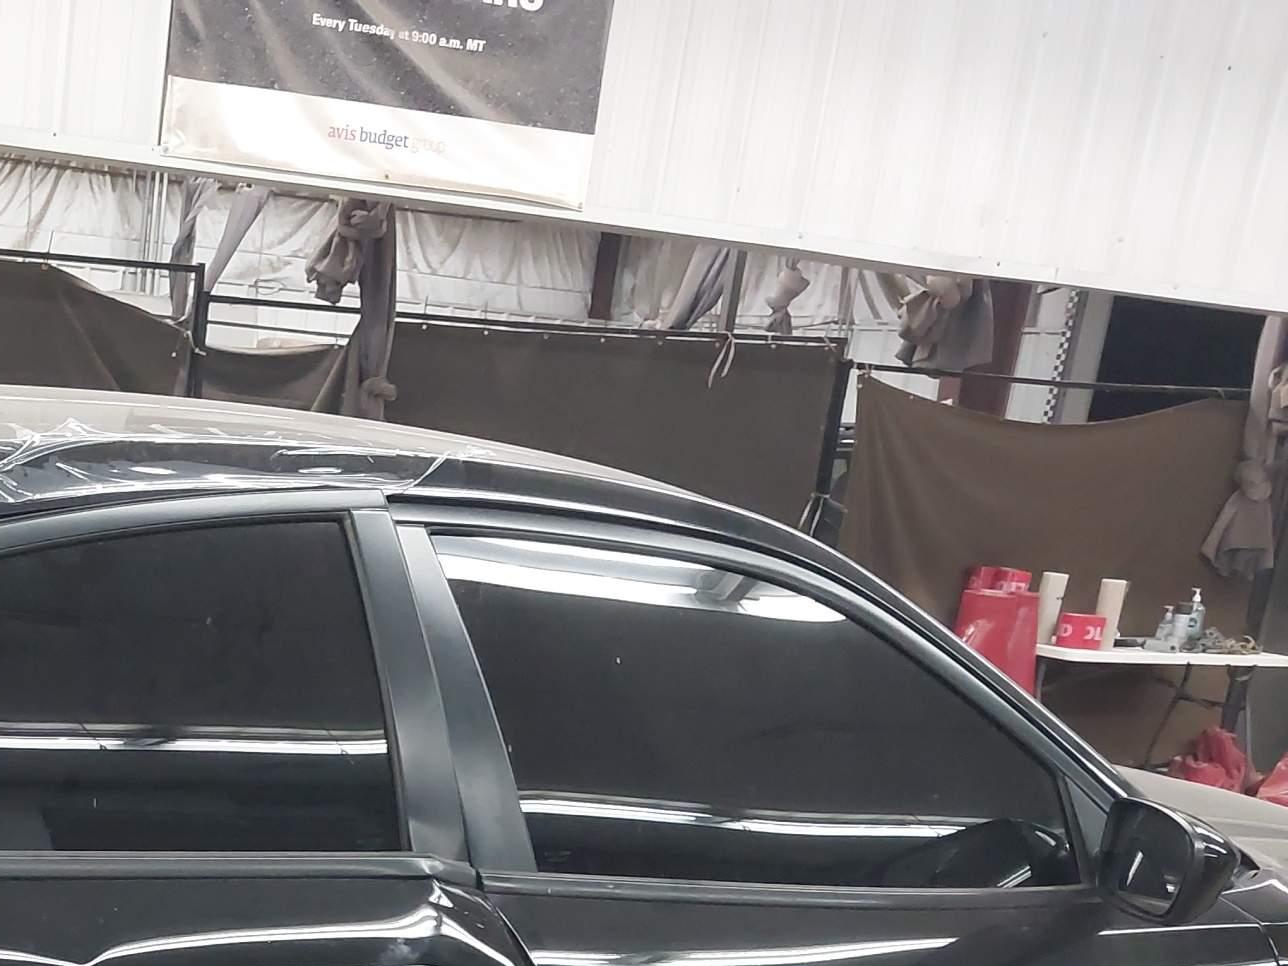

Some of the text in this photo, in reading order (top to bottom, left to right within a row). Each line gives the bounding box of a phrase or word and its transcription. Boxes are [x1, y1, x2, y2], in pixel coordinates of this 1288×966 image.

[312, 13, 486, 52] Every Tuesday at 9:00 a.m. MT
[327, 124, 447, 155] avis budget goup
